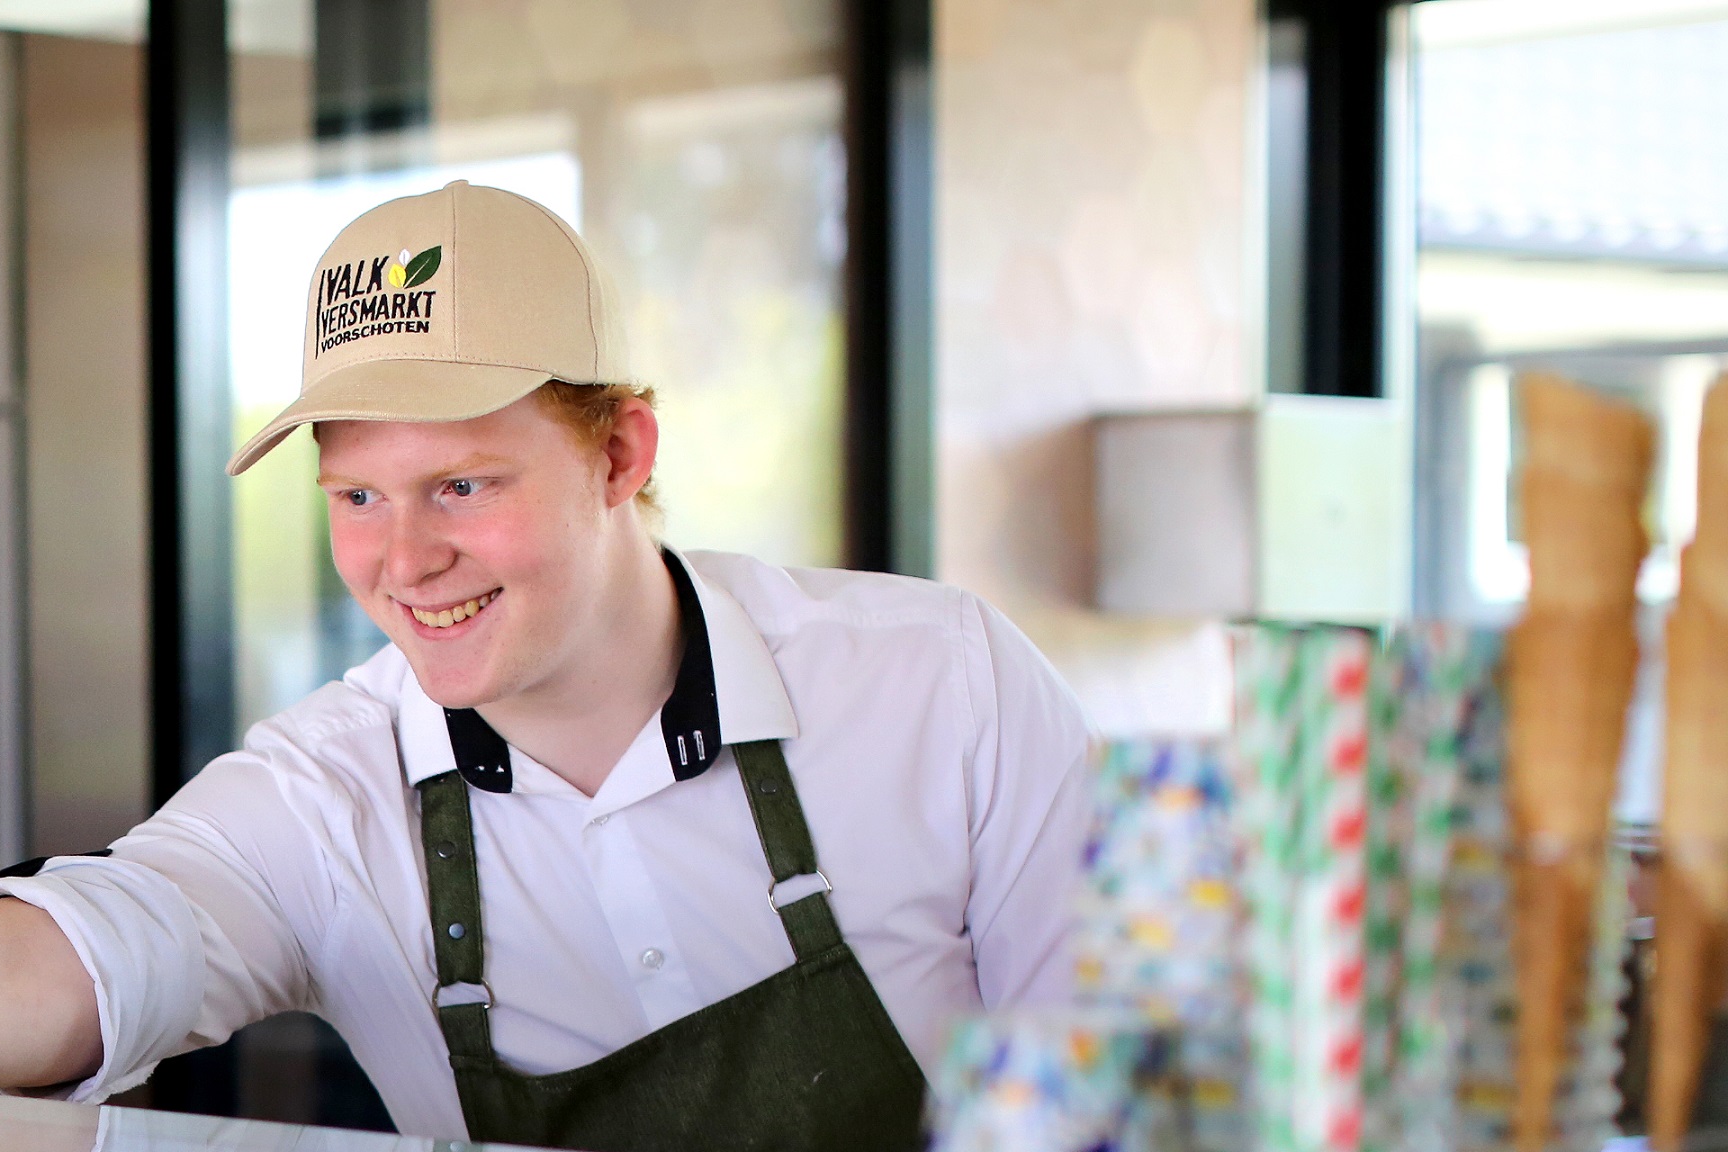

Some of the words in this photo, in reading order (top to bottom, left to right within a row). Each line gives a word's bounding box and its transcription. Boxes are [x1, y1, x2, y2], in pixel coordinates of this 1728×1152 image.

[327, 256, 390, 306] VALK
[321, 291, 436, 338] VERSMARKT
[321, 321, 430, 353] VOORSCHOTEN
